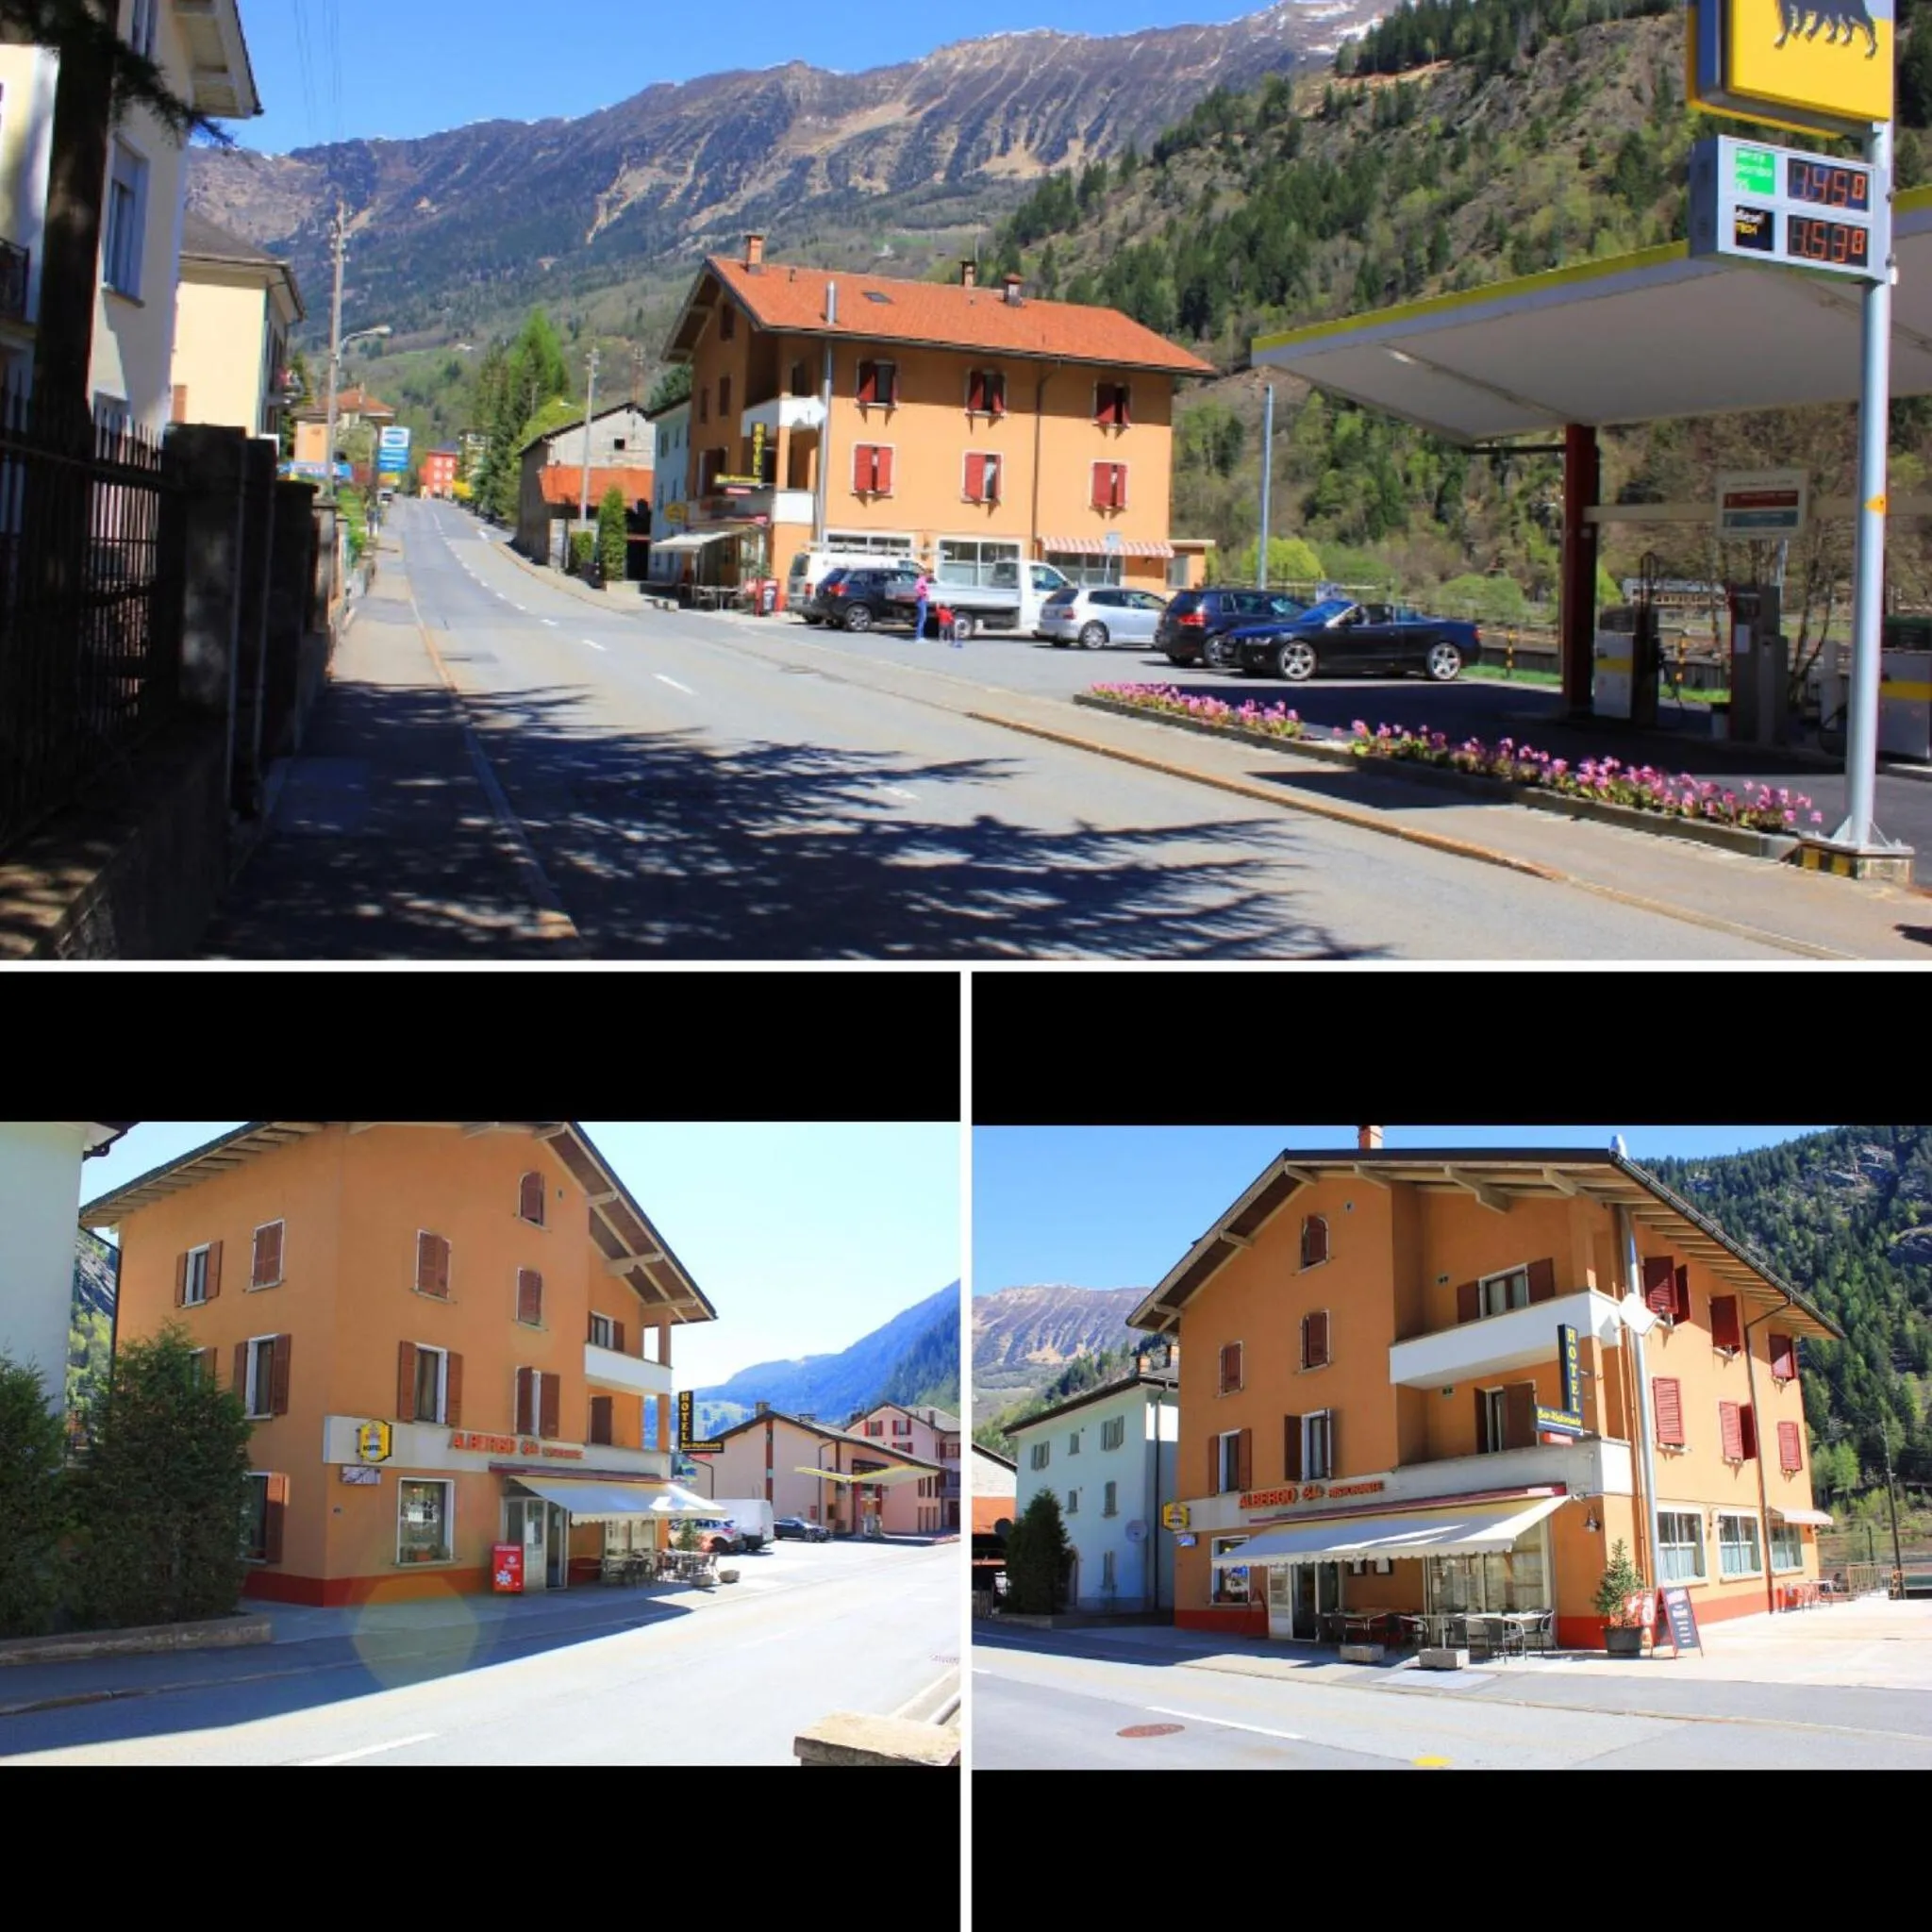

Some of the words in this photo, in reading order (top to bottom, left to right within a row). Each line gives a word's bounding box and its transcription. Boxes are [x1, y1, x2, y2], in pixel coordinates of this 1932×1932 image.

[1567, 1327, 1580, 1413] HOTEL
[681, 1392, 691, 1441] HOTEL
[453, 1432, 518, 1456] ABERGO
